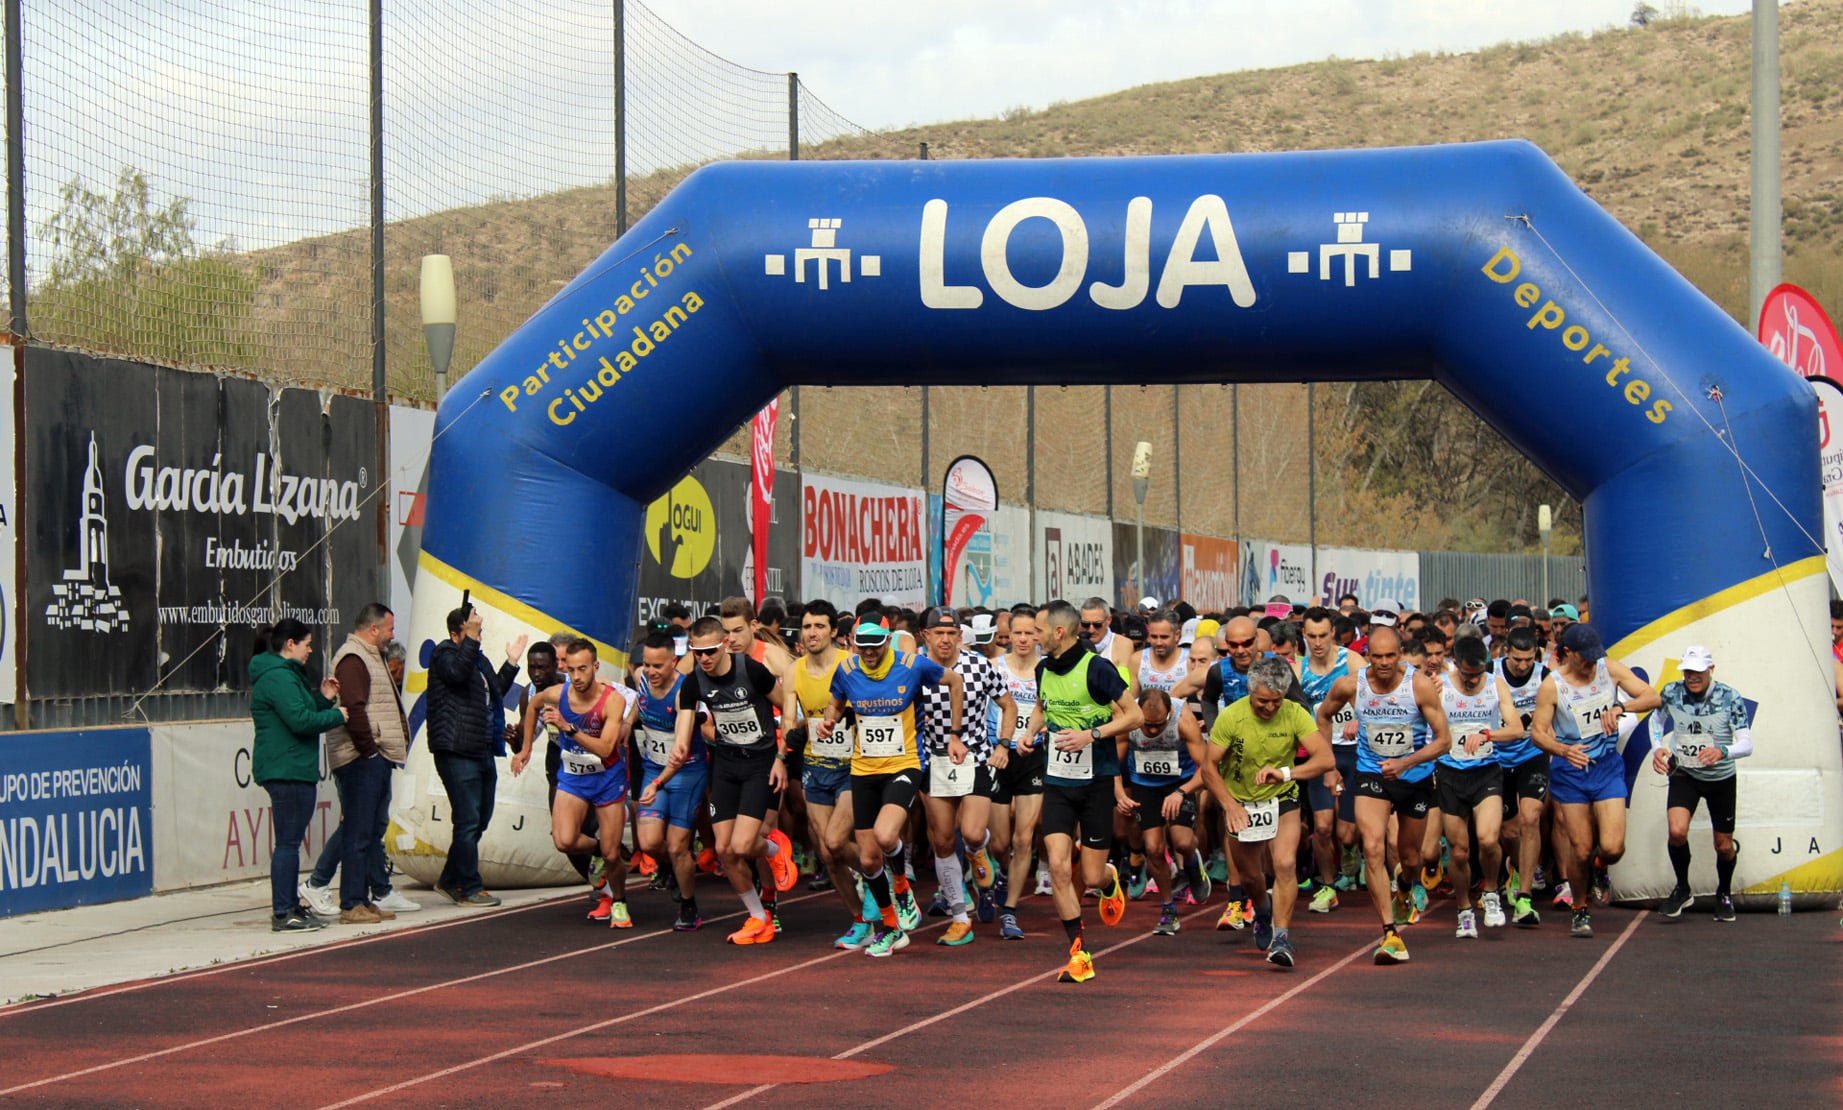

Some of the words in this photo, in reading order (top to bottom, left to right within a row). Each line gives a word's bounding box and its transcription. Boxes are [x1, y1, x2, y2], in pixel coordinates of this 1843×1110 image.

[919, 194, 1257, 310] LOJA
[499, 242, 693, 413] Participación
[1481, 246, 1673, 424] Deportes
[547, 290, 705, 427] Ciudadana
[125, 444, 247, 516] García
[804, 485, 923, 566] BONACHERA
[205, 537, 297, 571] Embutidos
[1067, 543, 1105, 585] ABADES
[858, 569, 890, 593] ROSCOS
[892, 568, 903, 591] DE
[158, 600, 340, 629] www.embutidosgarcalizana.com
[857, 696, 904, 710] agustinos
[1363, 707, 1409, 717] MARACENA
[1448, 709, 1493, 719] MARACENA
[719, 720, 758, 735] 3058
[865, 728, 895, 743] 597
[1374, 732, 1406, 745] 472
[569, 762, 596, 773] 579
[1055, 746, 1084, 764] 737
[1143, 761, 1172, 775] 669
[31, 770, 51, 800] DE
[53, 759, 141, 798] PREVENCIÓN
[947, 768, 958, 782] 4
[0, 806, 145, 891] NDALUCIA
